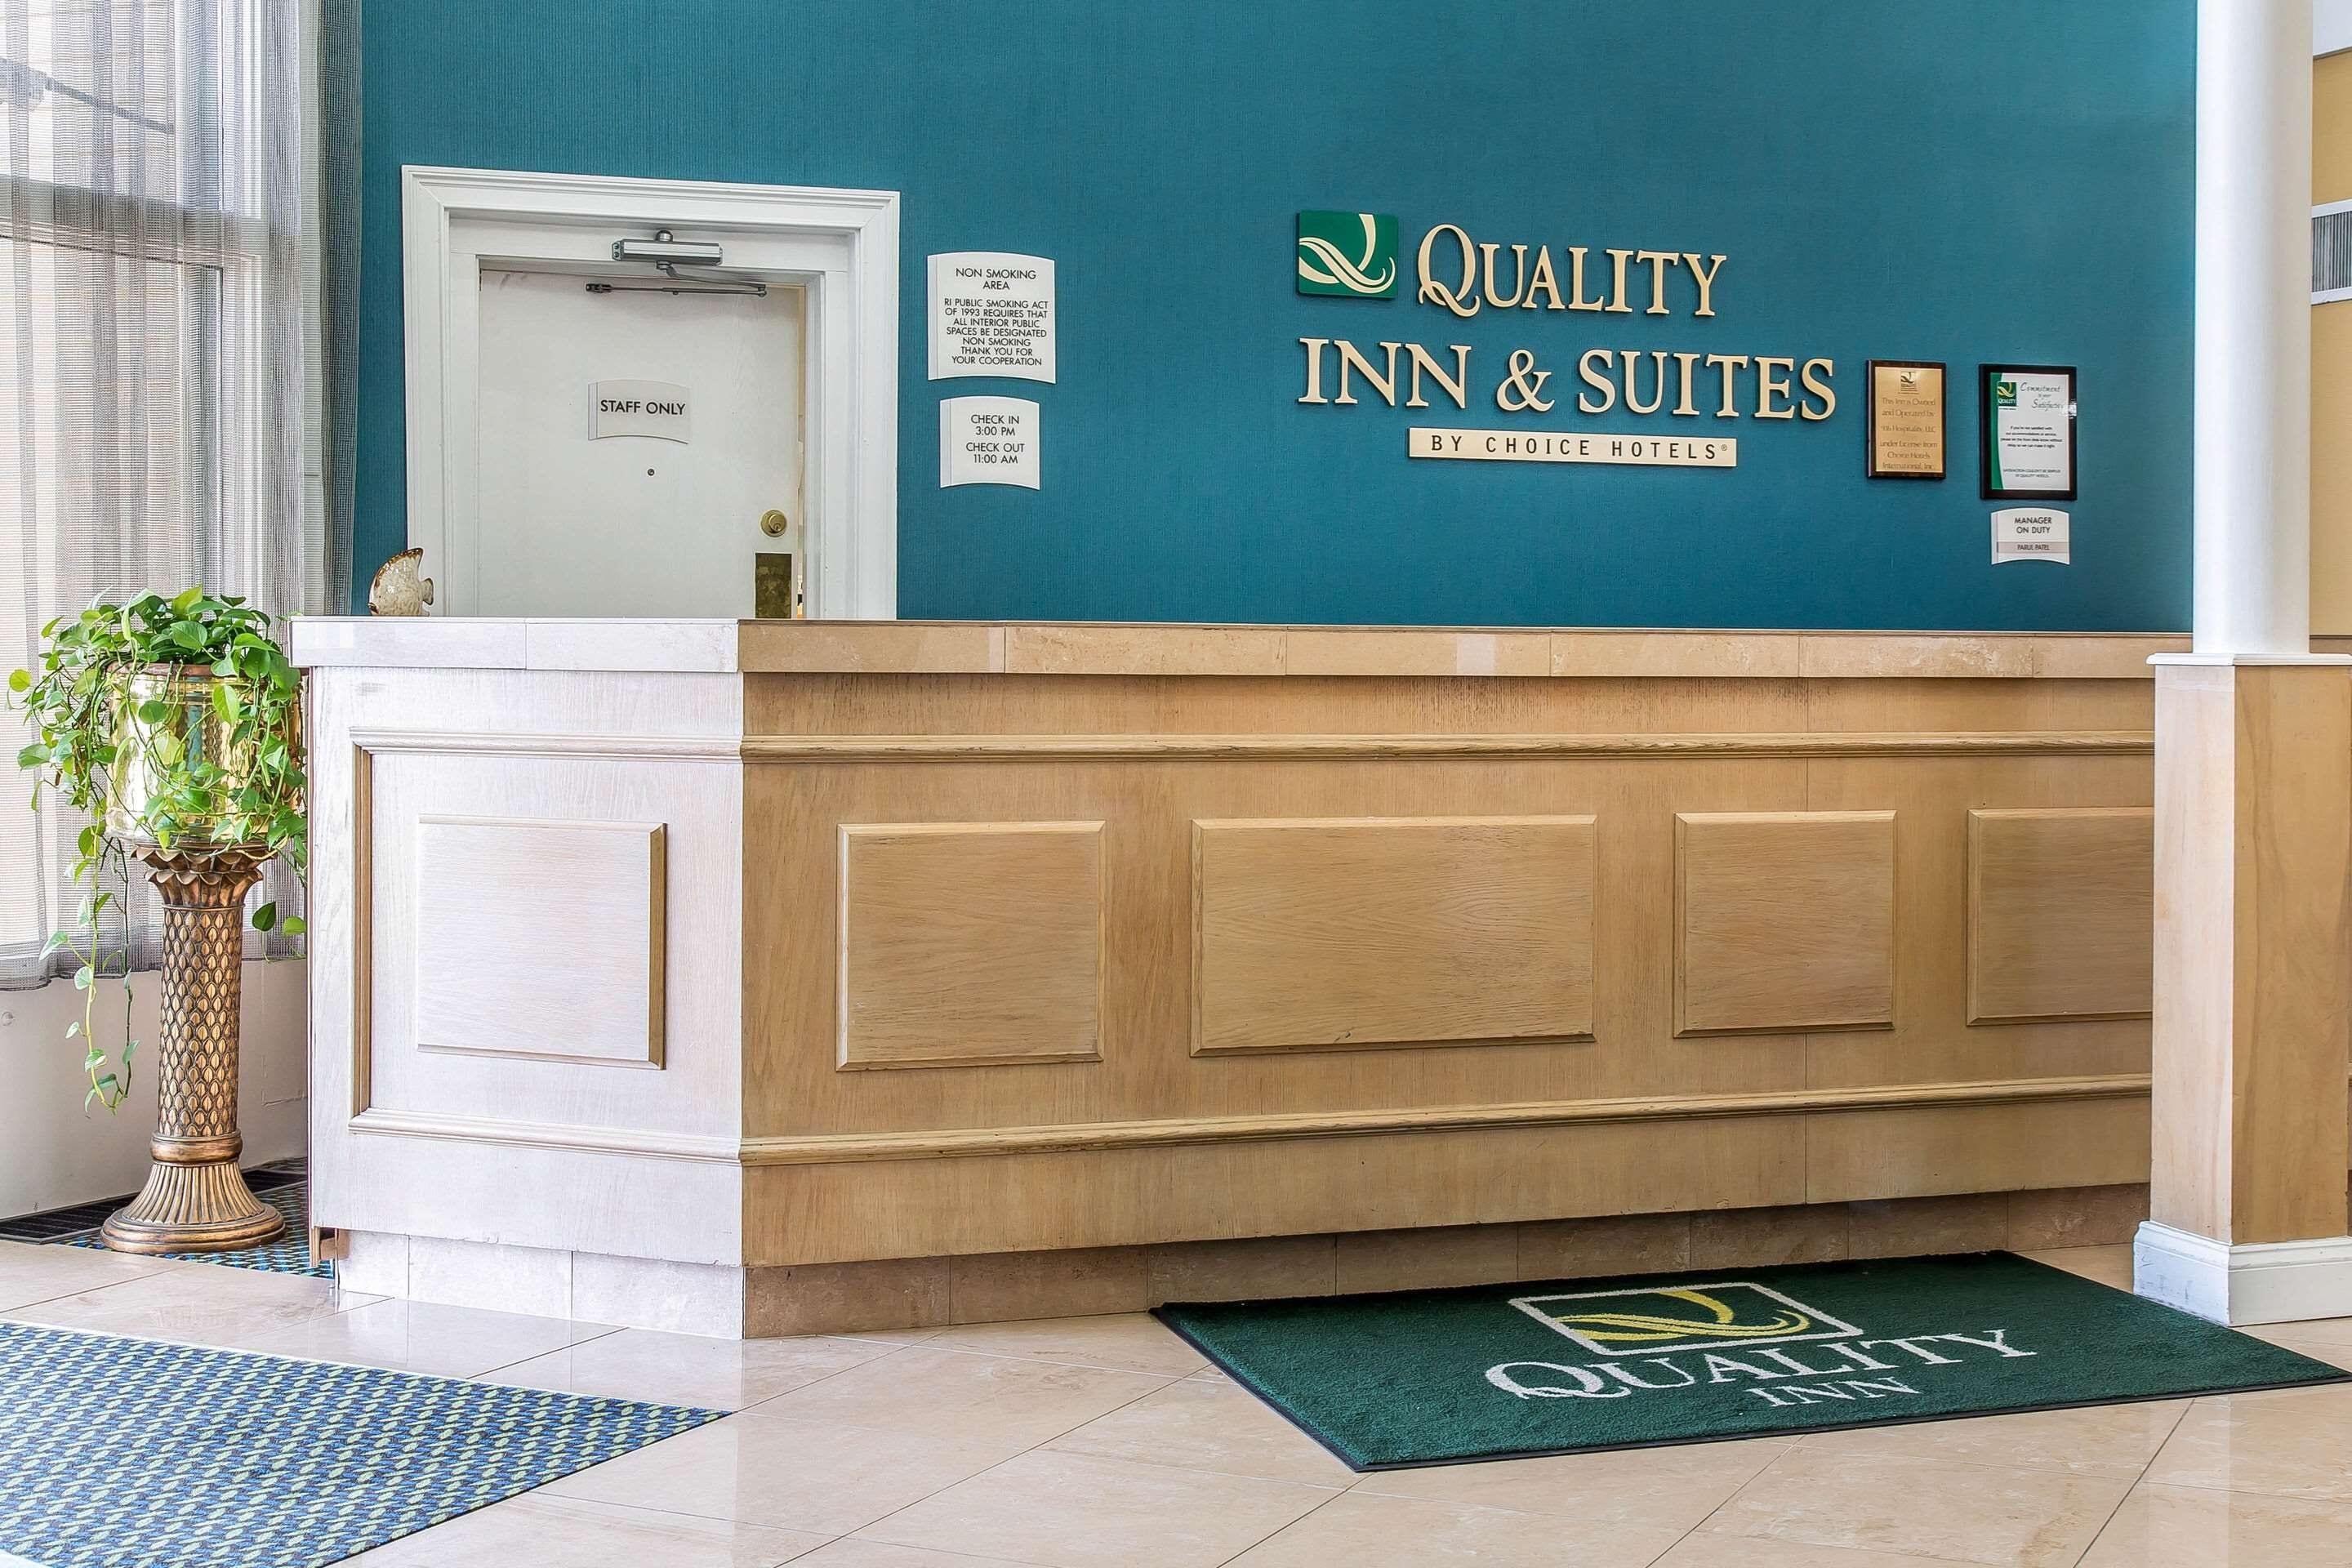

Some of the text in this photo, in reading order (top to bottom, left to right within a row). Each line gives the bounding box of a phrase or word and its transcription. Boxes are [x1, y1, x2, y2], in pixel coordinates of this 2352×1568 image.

[956, 268, 1036, 279] NON SMOKING
[1418, 224, 1727, 318] QUALITY
[982, 281, 1010, 290] AREA
[955, 299, 983, 307] PUBLIC
[986, 300, 1029, 309] SMOKING
[945, 308, 1048, 318] OF 1993 REQUIRES THAT
[970, 318, 1009, 327] INTERIOR
[1012, 319, 1040, 327] PUBLIC
[946, 327, 978, 336] SPACES
[993, 328, 1047, 337] DESIGNATED
[962, 337, 1031, 346] NON SMOKING
[960, 346, 1033, 356] THANK YOU FOR
[951, 355, 1042, 366] YOUR COOPERATION
[1298, 337, 1836, 421] INN & SUITES
[600, 399, 686, 415] STAFF ONLY
[970, 414, 1020, 424] CHECK IN
[975, 426, 1015, 436] 3:00 PM
[965, 442, 1025, 452] CHECK OUT
[1431, 434, 1463, 452] BY
[1486, 437, 1590, 457] CHOICE
[973, 454, 1018, 464] 11:00 AM
[1485, 1328, 2038, 1400] QUALITY
[1746, 1375, 1922, 1408] INN
